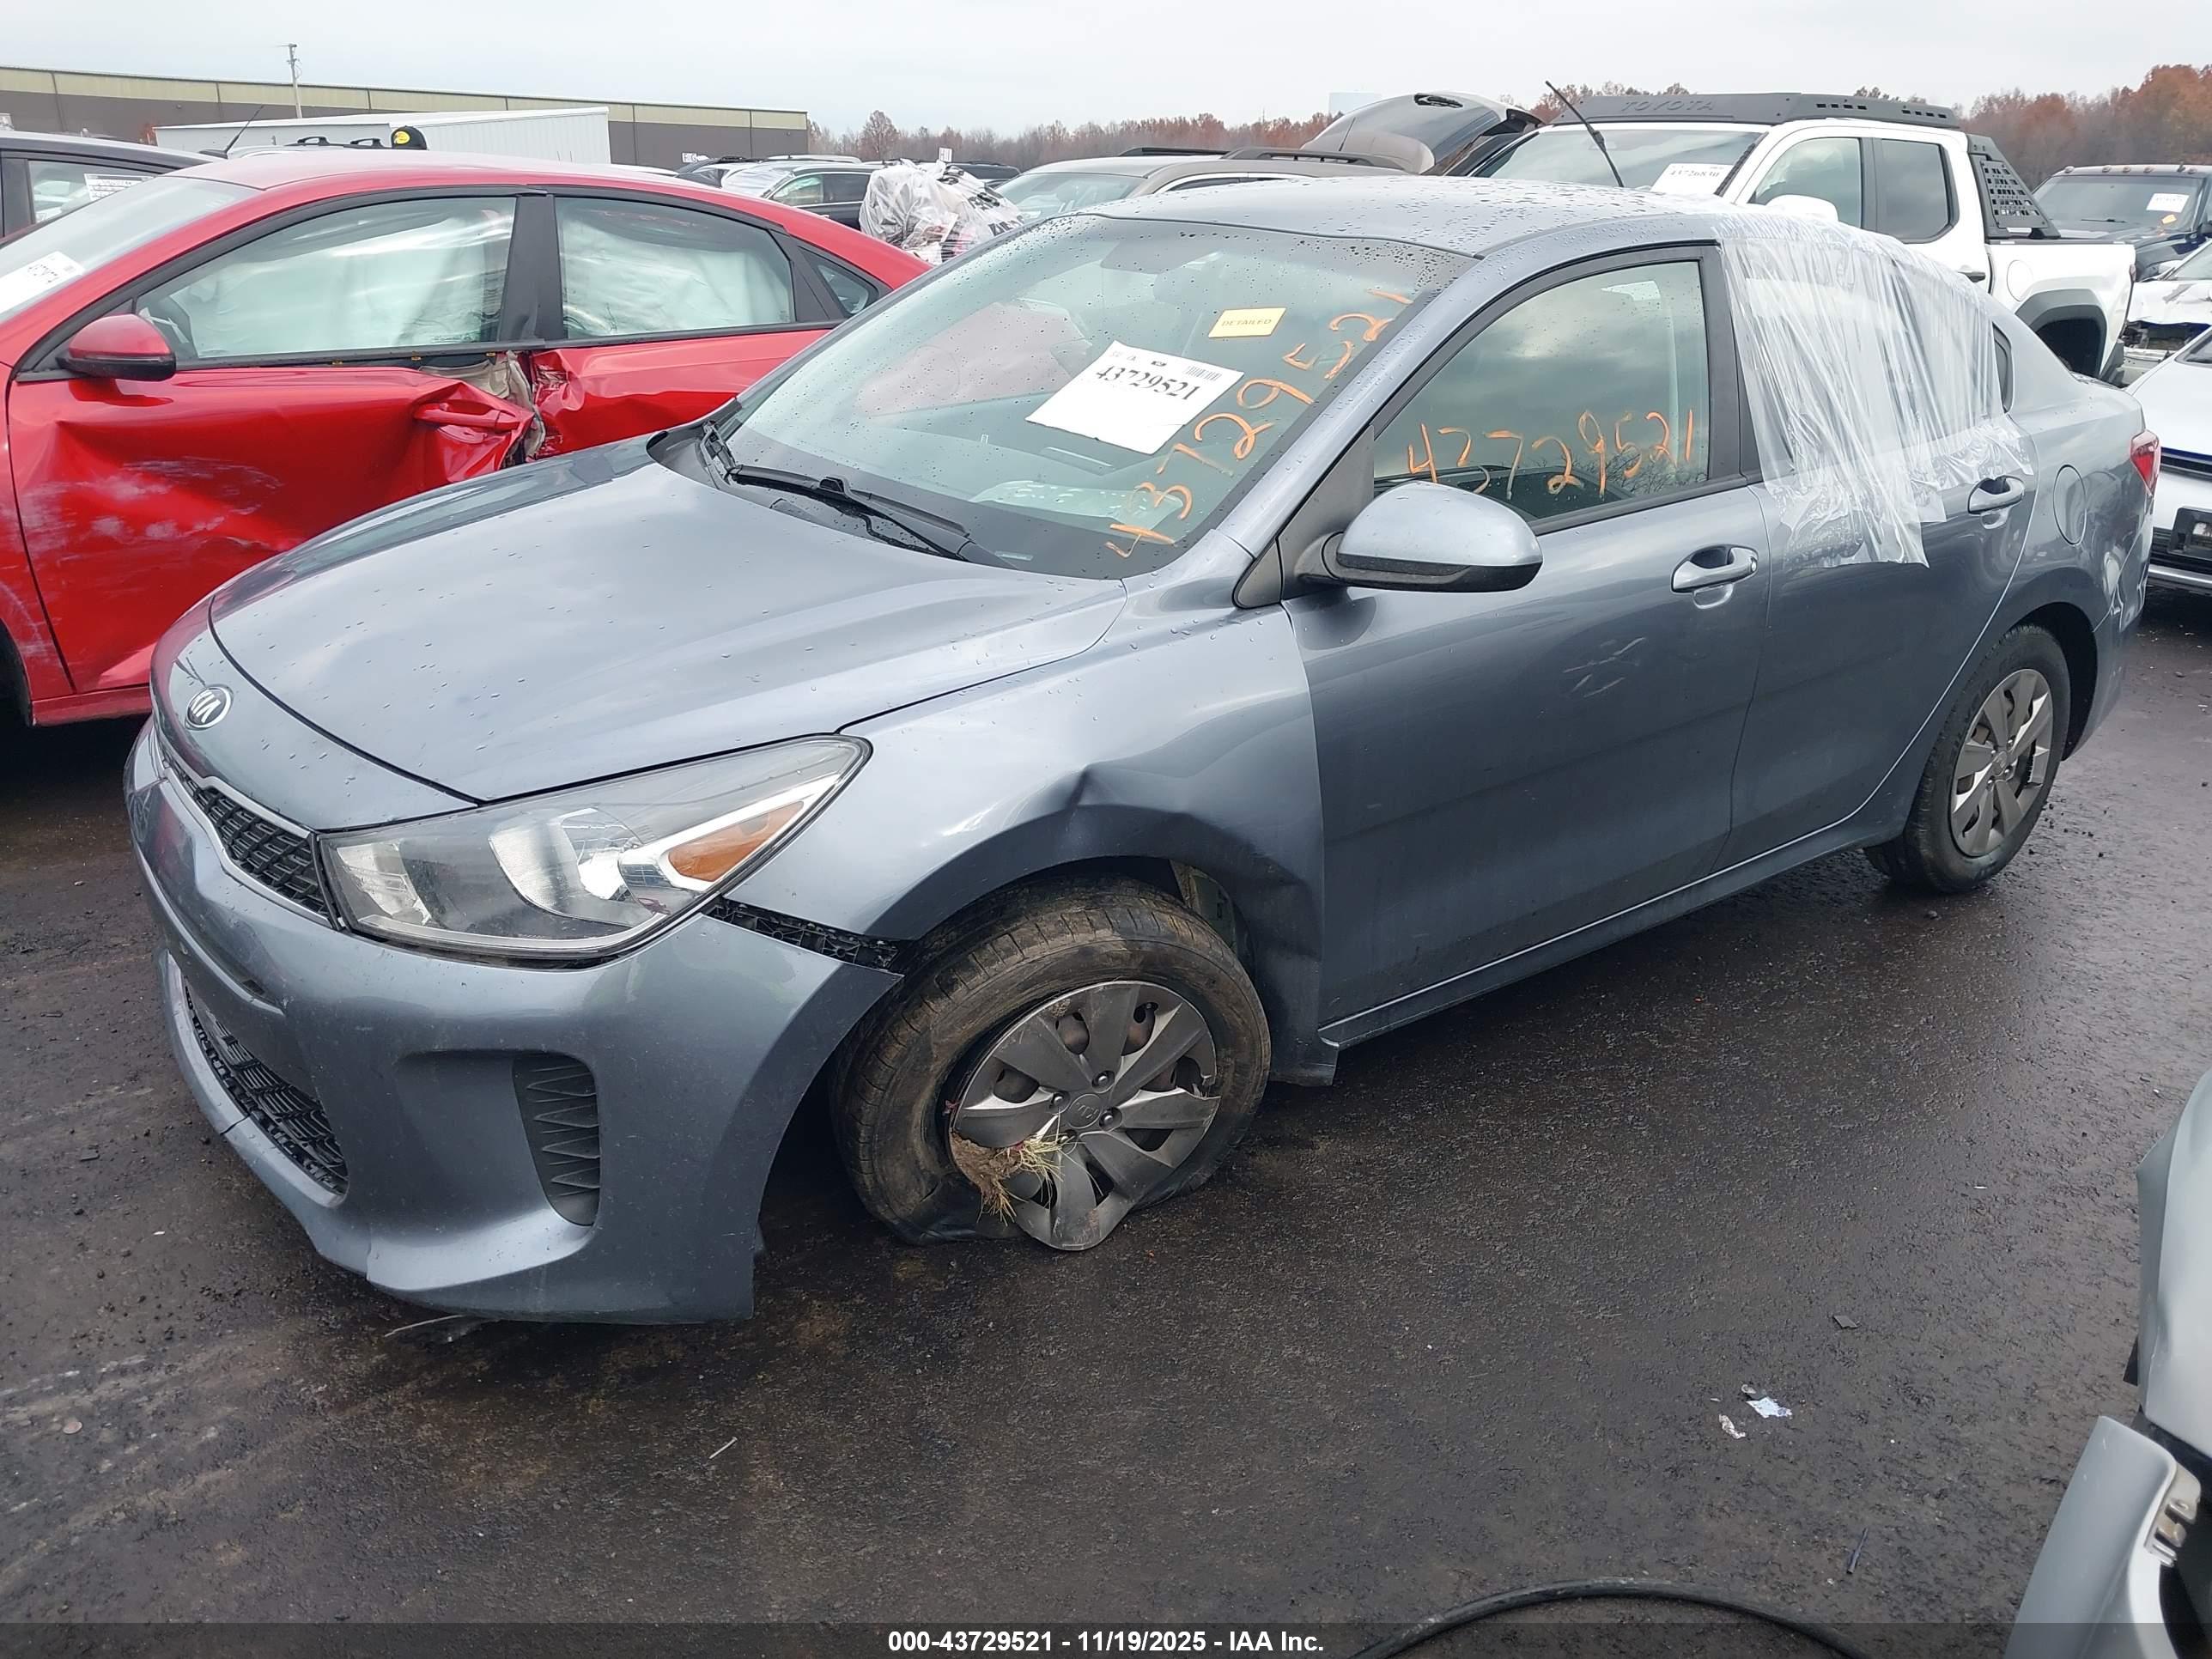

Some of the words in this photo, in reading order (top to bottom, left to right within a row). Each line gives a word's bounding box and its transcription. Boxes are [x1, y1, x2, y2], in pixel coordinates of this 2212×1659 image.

[1621, 100, 1714, 111] TOYOTA
[1096, 365, 1200, 400] 43729521
[1407, 410, 1694, 501] 43729521
